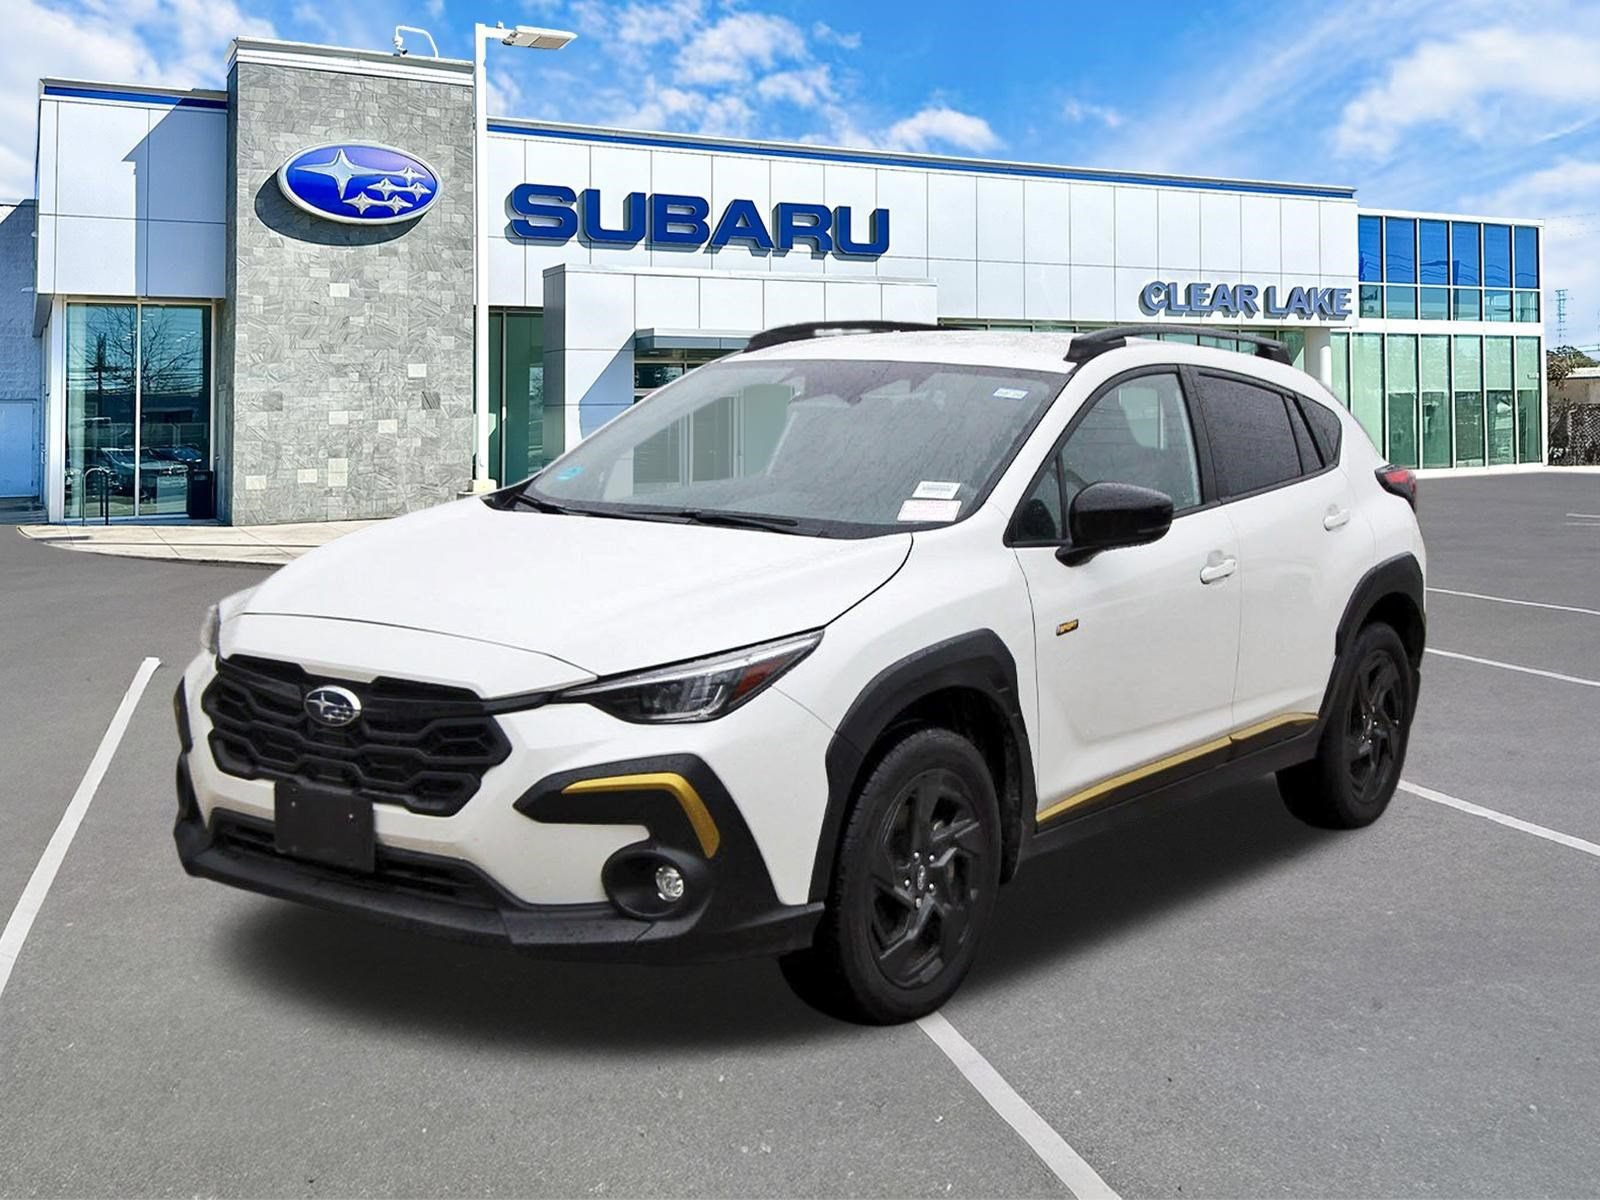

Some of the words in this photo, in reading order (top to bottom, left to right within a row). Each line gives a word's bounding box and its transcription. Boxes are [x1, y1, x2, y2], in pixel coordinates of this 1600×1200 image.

[505, 183, 890, 259] SUBARU
[1140, 281, 1259, 317] CLEAR
[1264, 286, 1352, 319] LAKE
